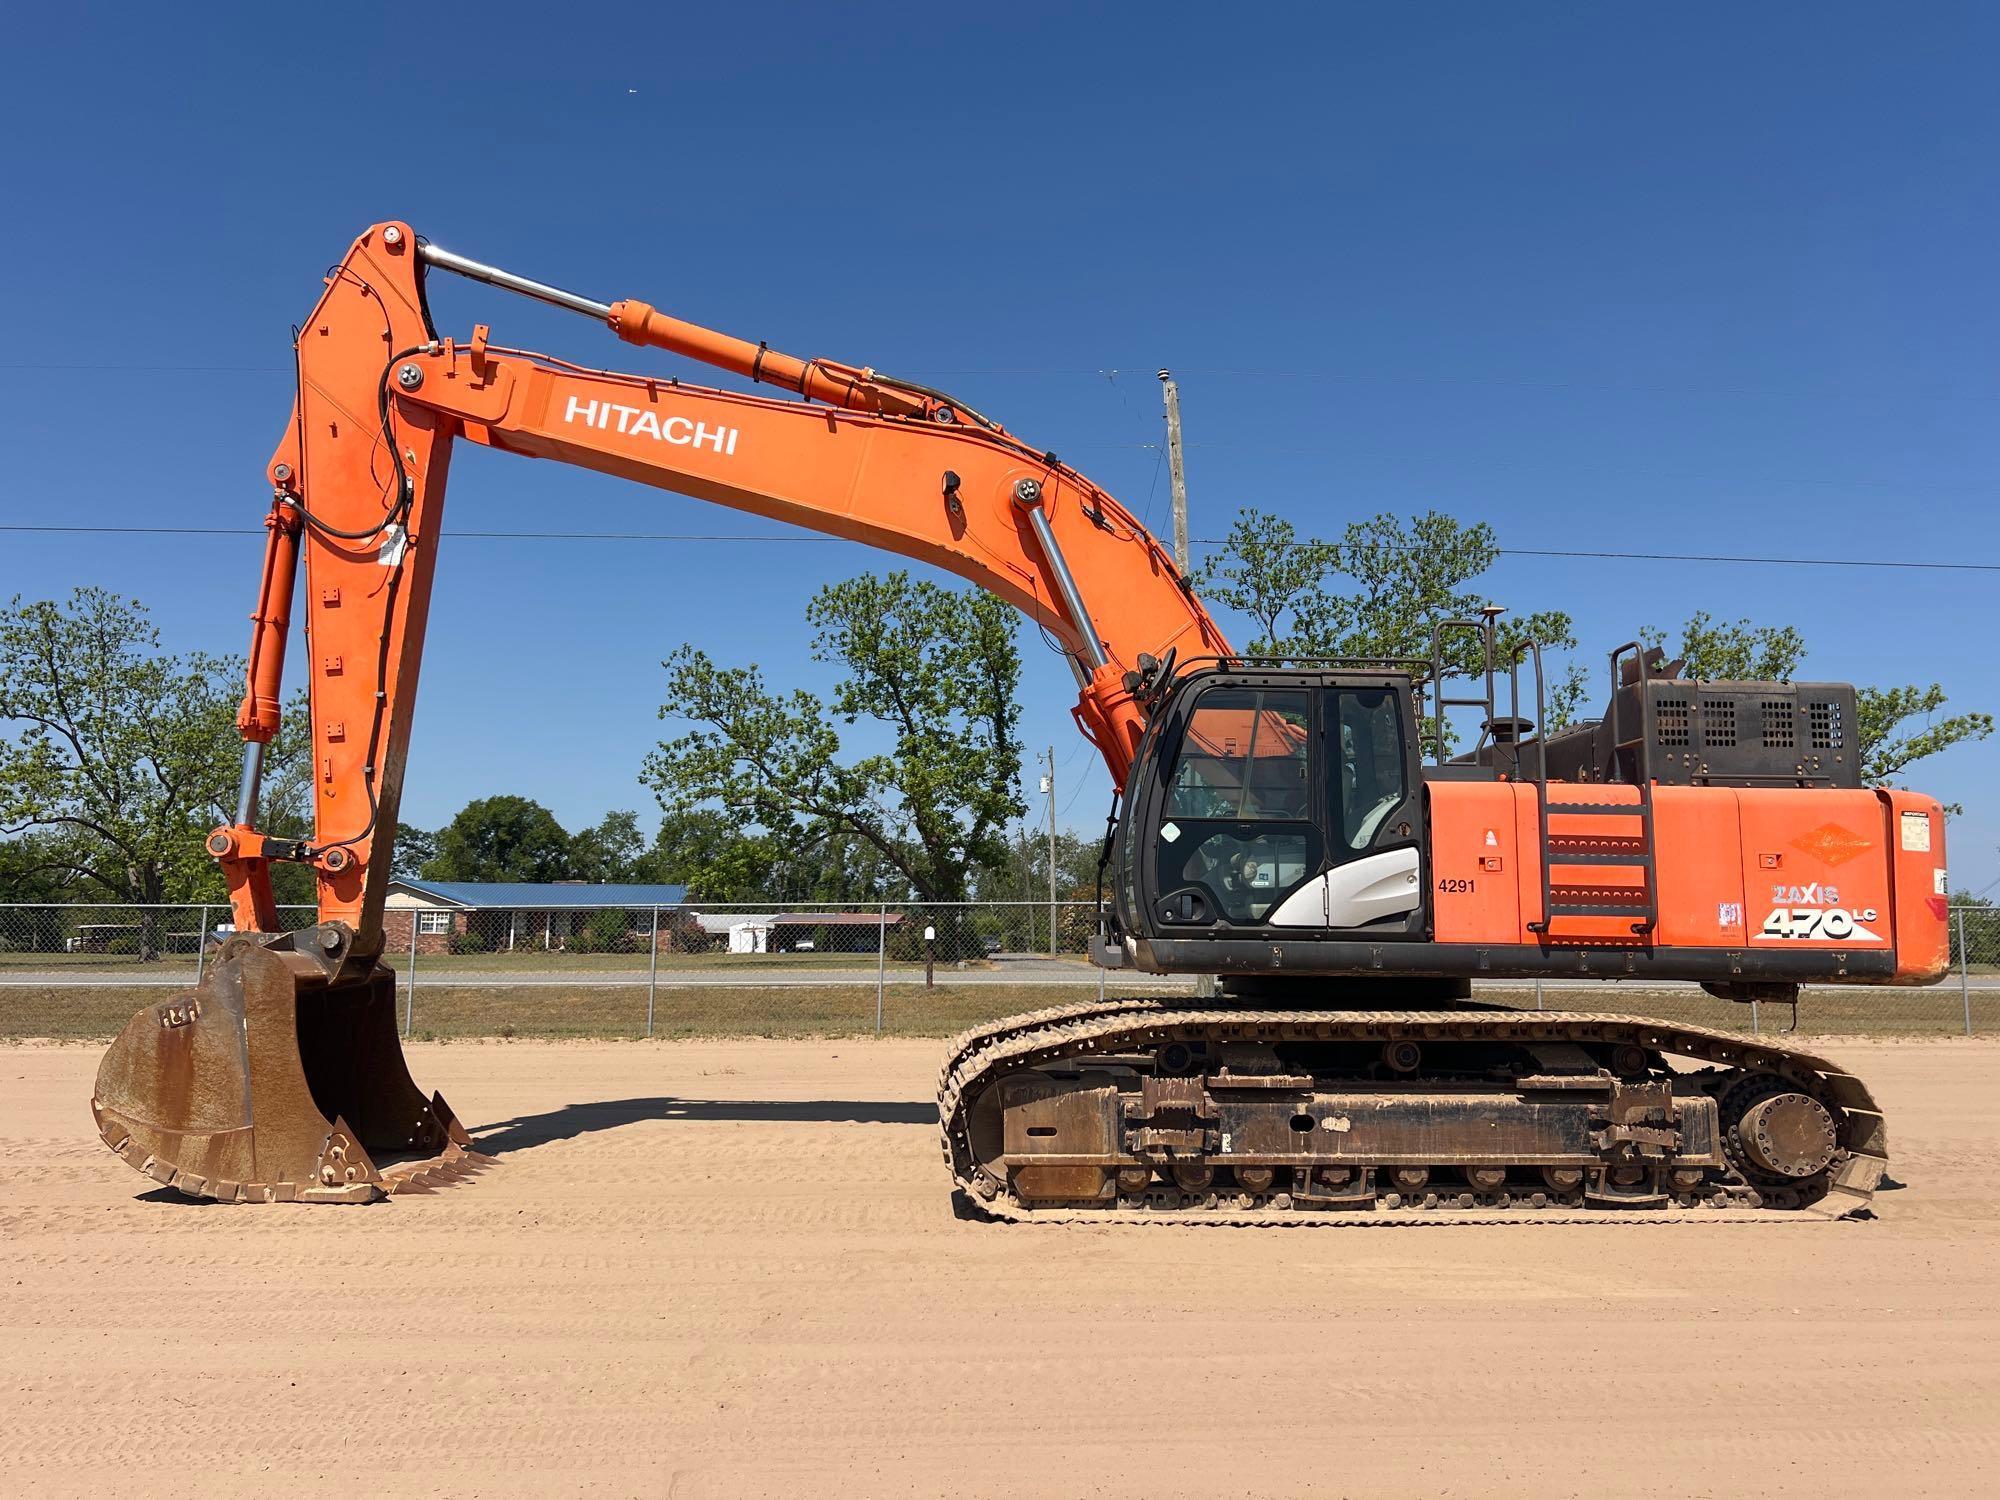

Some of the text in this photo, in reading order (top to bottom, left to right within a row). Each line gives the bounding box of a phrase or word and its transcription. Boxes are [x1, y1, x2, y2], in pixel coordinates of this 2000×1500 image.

[564, 395, 739, 456] HITACHI
[1438, 879, 1475, 893] 4291
[1771, 882, 1840, 905] ZAXIS
